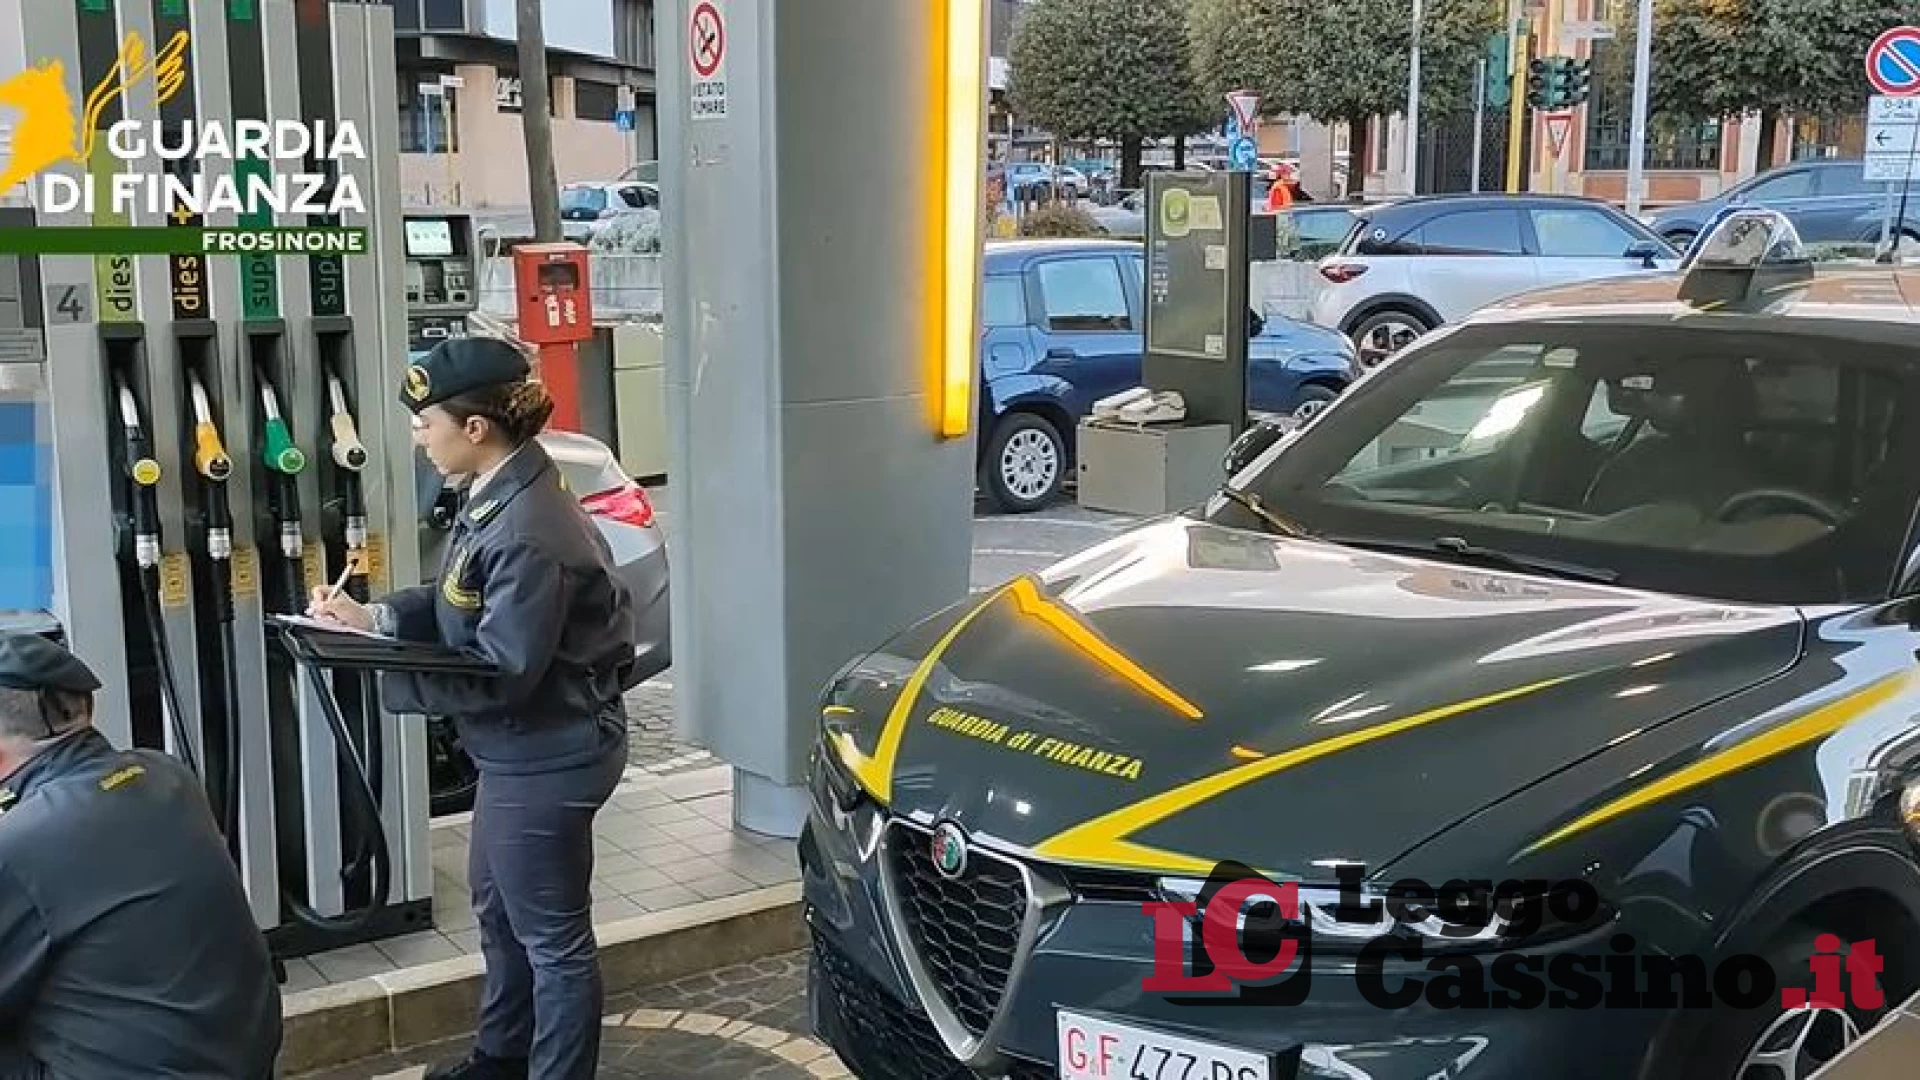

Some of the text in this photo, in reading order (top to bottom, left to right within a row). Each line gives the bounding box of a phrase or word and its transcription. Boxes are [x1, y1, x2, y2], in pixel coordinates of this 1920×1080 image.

[56, 284, 83, 321] 4
[105, 256, 133, 312] dies
[173, 256, 200, 311] dies
[926, 706, 1144, 780] GUARDIA di FINANZA
[1129, 1043, 1198, 1080] 477
